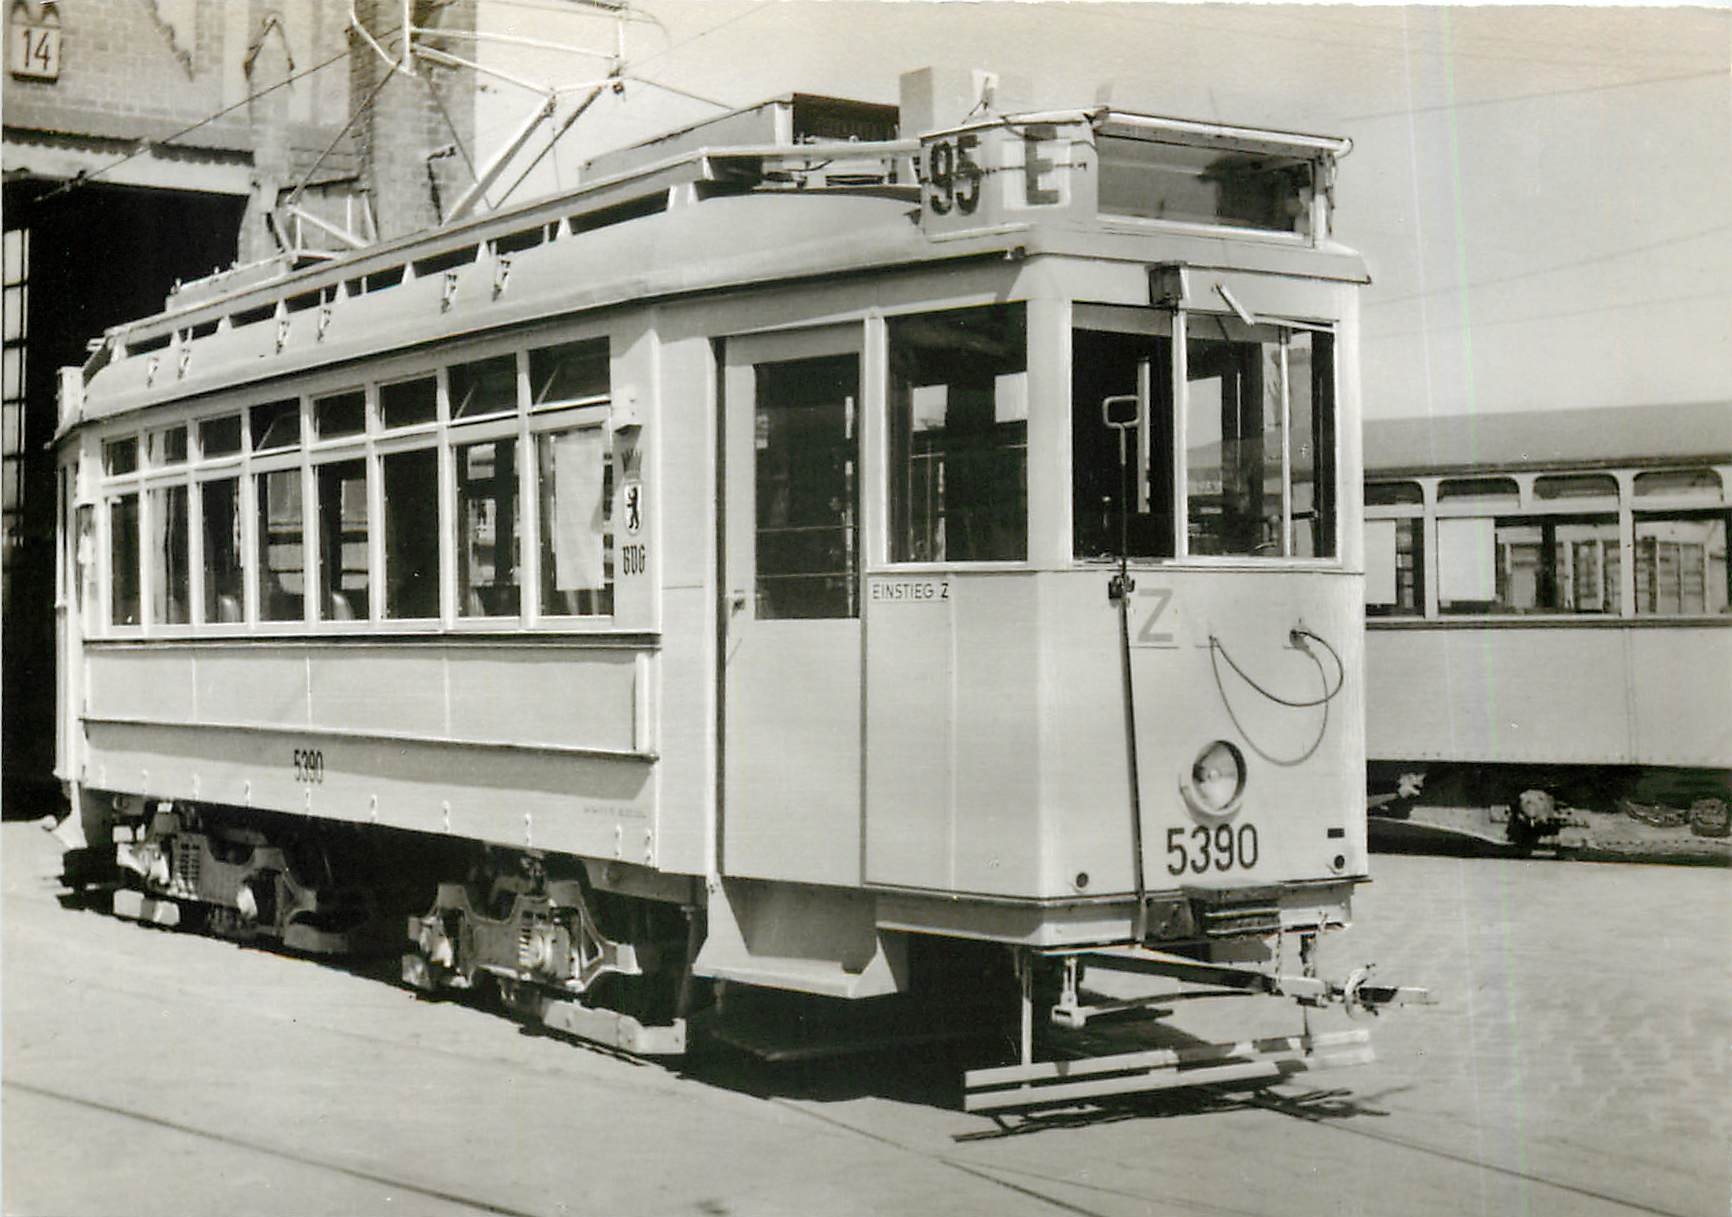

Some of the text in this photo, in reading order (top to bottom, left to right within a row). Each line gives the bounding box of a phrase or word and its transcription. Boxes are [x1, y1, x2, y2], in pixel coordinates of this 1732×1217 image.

[23, 29, 51, 71] 14
[930, 124, 1060, 216] 95 E
[872, 583, 934, 600] EINSTIEG
[1137, 587, 1175, 643] Z
[293, 749, 324, 785] 5390
[1166, 822, 1259, 877] 5390
